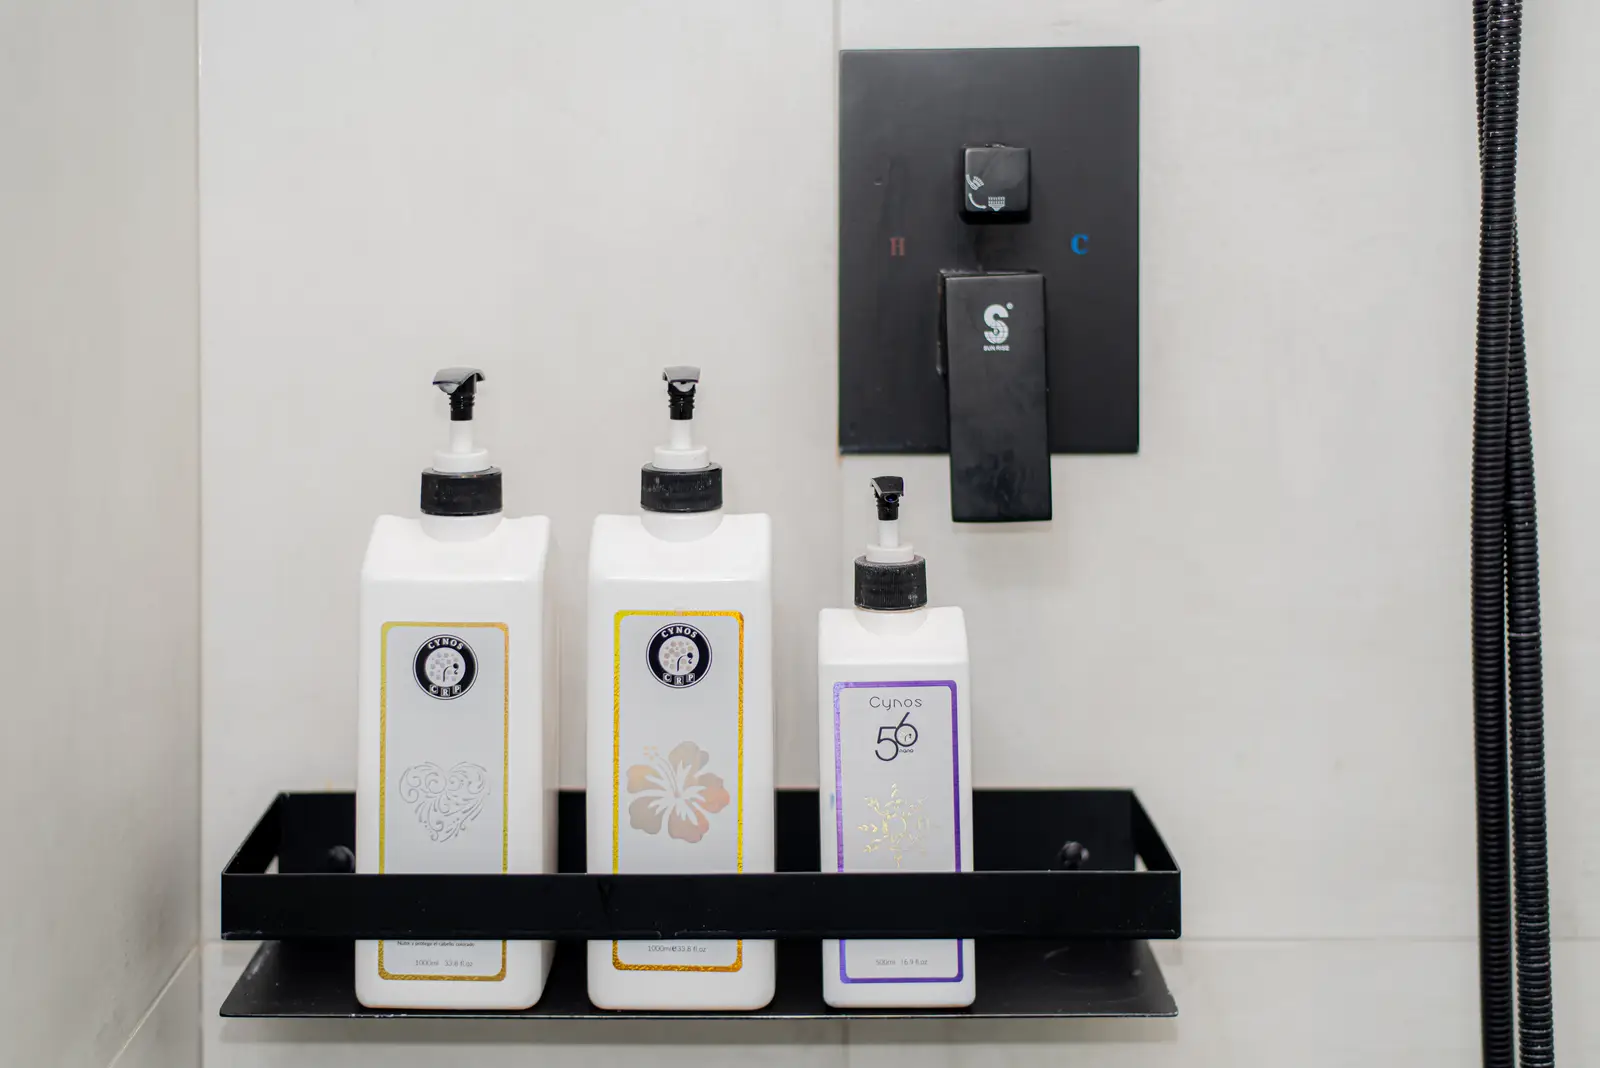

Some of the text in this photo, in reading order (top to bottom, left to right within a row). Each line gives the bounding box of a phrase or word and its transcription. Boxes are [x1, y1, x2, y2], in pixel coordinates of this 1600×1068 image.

[890, 237, 905, 256] H
[1071, 234, 1089, 255] C
[984, 304, 1009, 344] S
[661, 626, 698, 639] CYNOS
[428, 638, 464, 650] CYNOS
[869, 696, 922, 711] Cynos
[875, 712, 918, 761] 56
